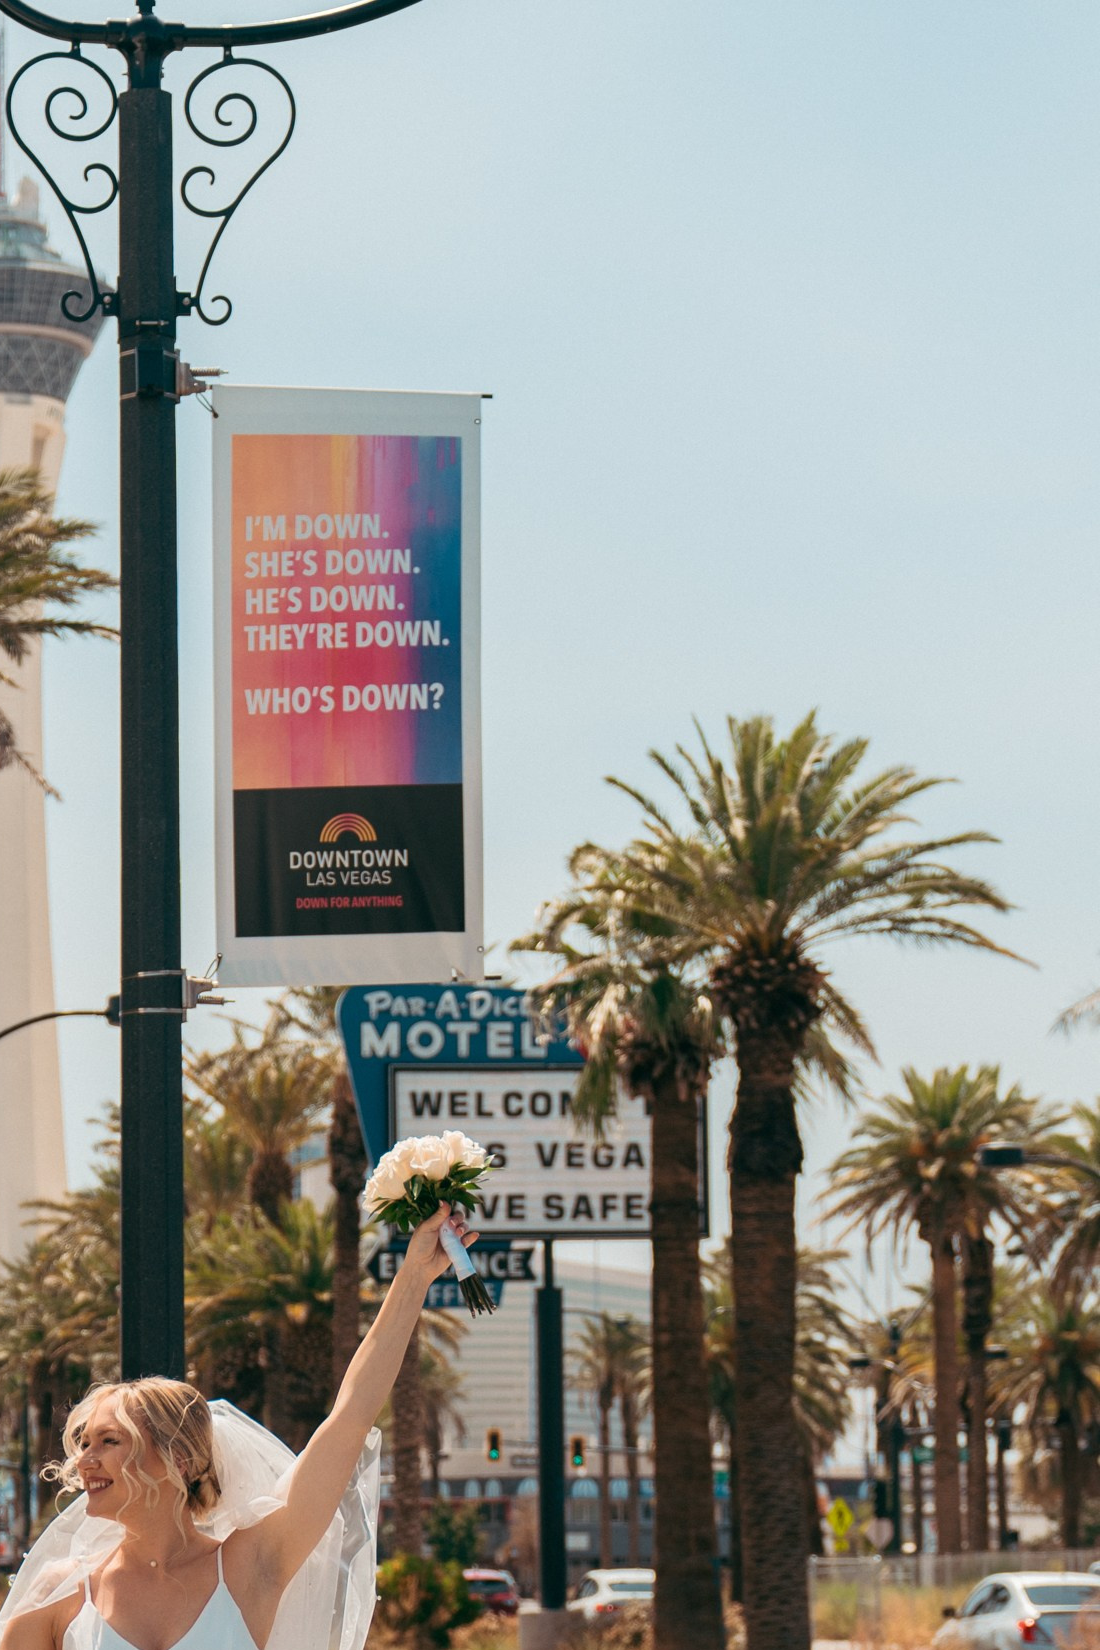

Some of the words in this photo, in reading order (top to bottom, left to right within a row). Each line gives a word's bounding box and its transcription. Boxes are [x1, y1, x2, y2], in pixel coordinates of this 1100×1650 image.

[245, 514, 286, 541] I'M
[294, 513, 390, 540] DOWN.
[244, 549, 318, 579] SHE'S
[325, 548, 421, 576] DOWN.
[245, 586, 302, 615] HE'S
[309, 584, 406, 613] DOWN.
[244, 621, 349, 651] THEY'RE
[355, 619, 450, 648] DOWN.
[244, 685, 335, 715] WHO'S
[342, 681, 445, 712] DOWN?
[289, 848, 409, 870] DOWNTOWN
[306, 871, 337, 887] LAS
[339, 869, 393, 886] VEGAS
[296, 896, 328, 909] DOWN
[330, 896, 349, 908] FOR
[351, 895, 404, 908] ANYTHING
[360, 1020, 549, 1059] MOTEL
[410, 1091, 617, 1117] WELCO
[536, 1141, 645, 1169] VEGA
